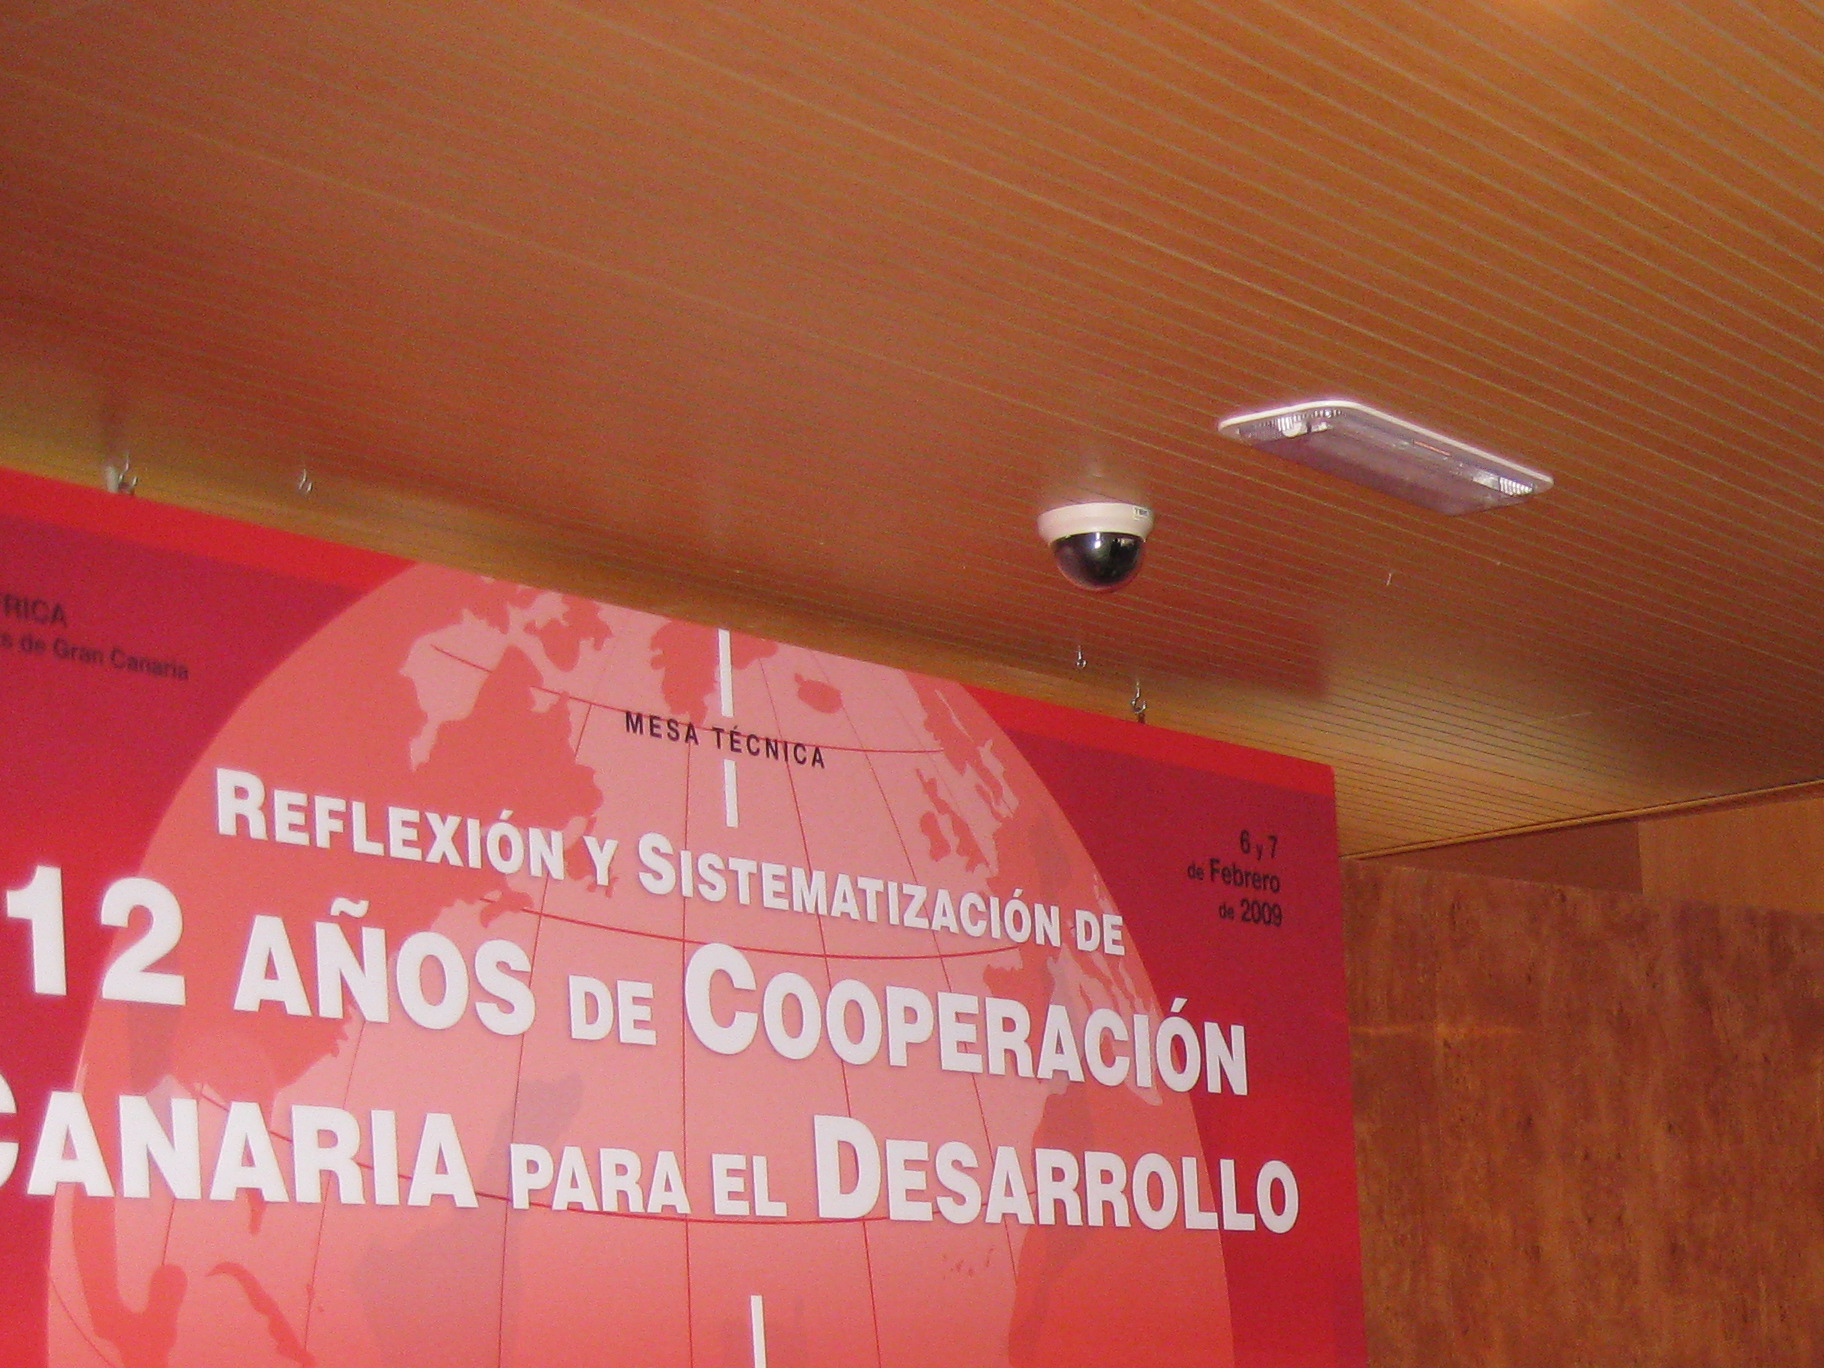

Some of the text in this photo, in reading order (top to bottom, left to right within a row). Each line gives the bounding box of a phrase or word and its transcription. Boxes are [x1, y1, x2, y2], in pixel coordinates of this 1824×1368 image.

[20, 633, 46, 654] de
[53, 636, 103, 664] Gran
[110, 646, 189, 680] Canaria
[625, 711, 825, 770] MESA TÉCNICA
[216, 767, 1126, 957] REFLEXIÓN Y SISTEMATIZACIÓN DE
[1239, 829, 1278, 861] 6 y 7
[1187, 858, 1281, 893] de Febrero
[1219, 898, 1283, 927] de 2009
[6, 865, 1249, 1097] 12 AÑOS DE COOPERACIÓN
[0, 1068, 1299, 1234] ANARIA PARA EL DESARROLLO
